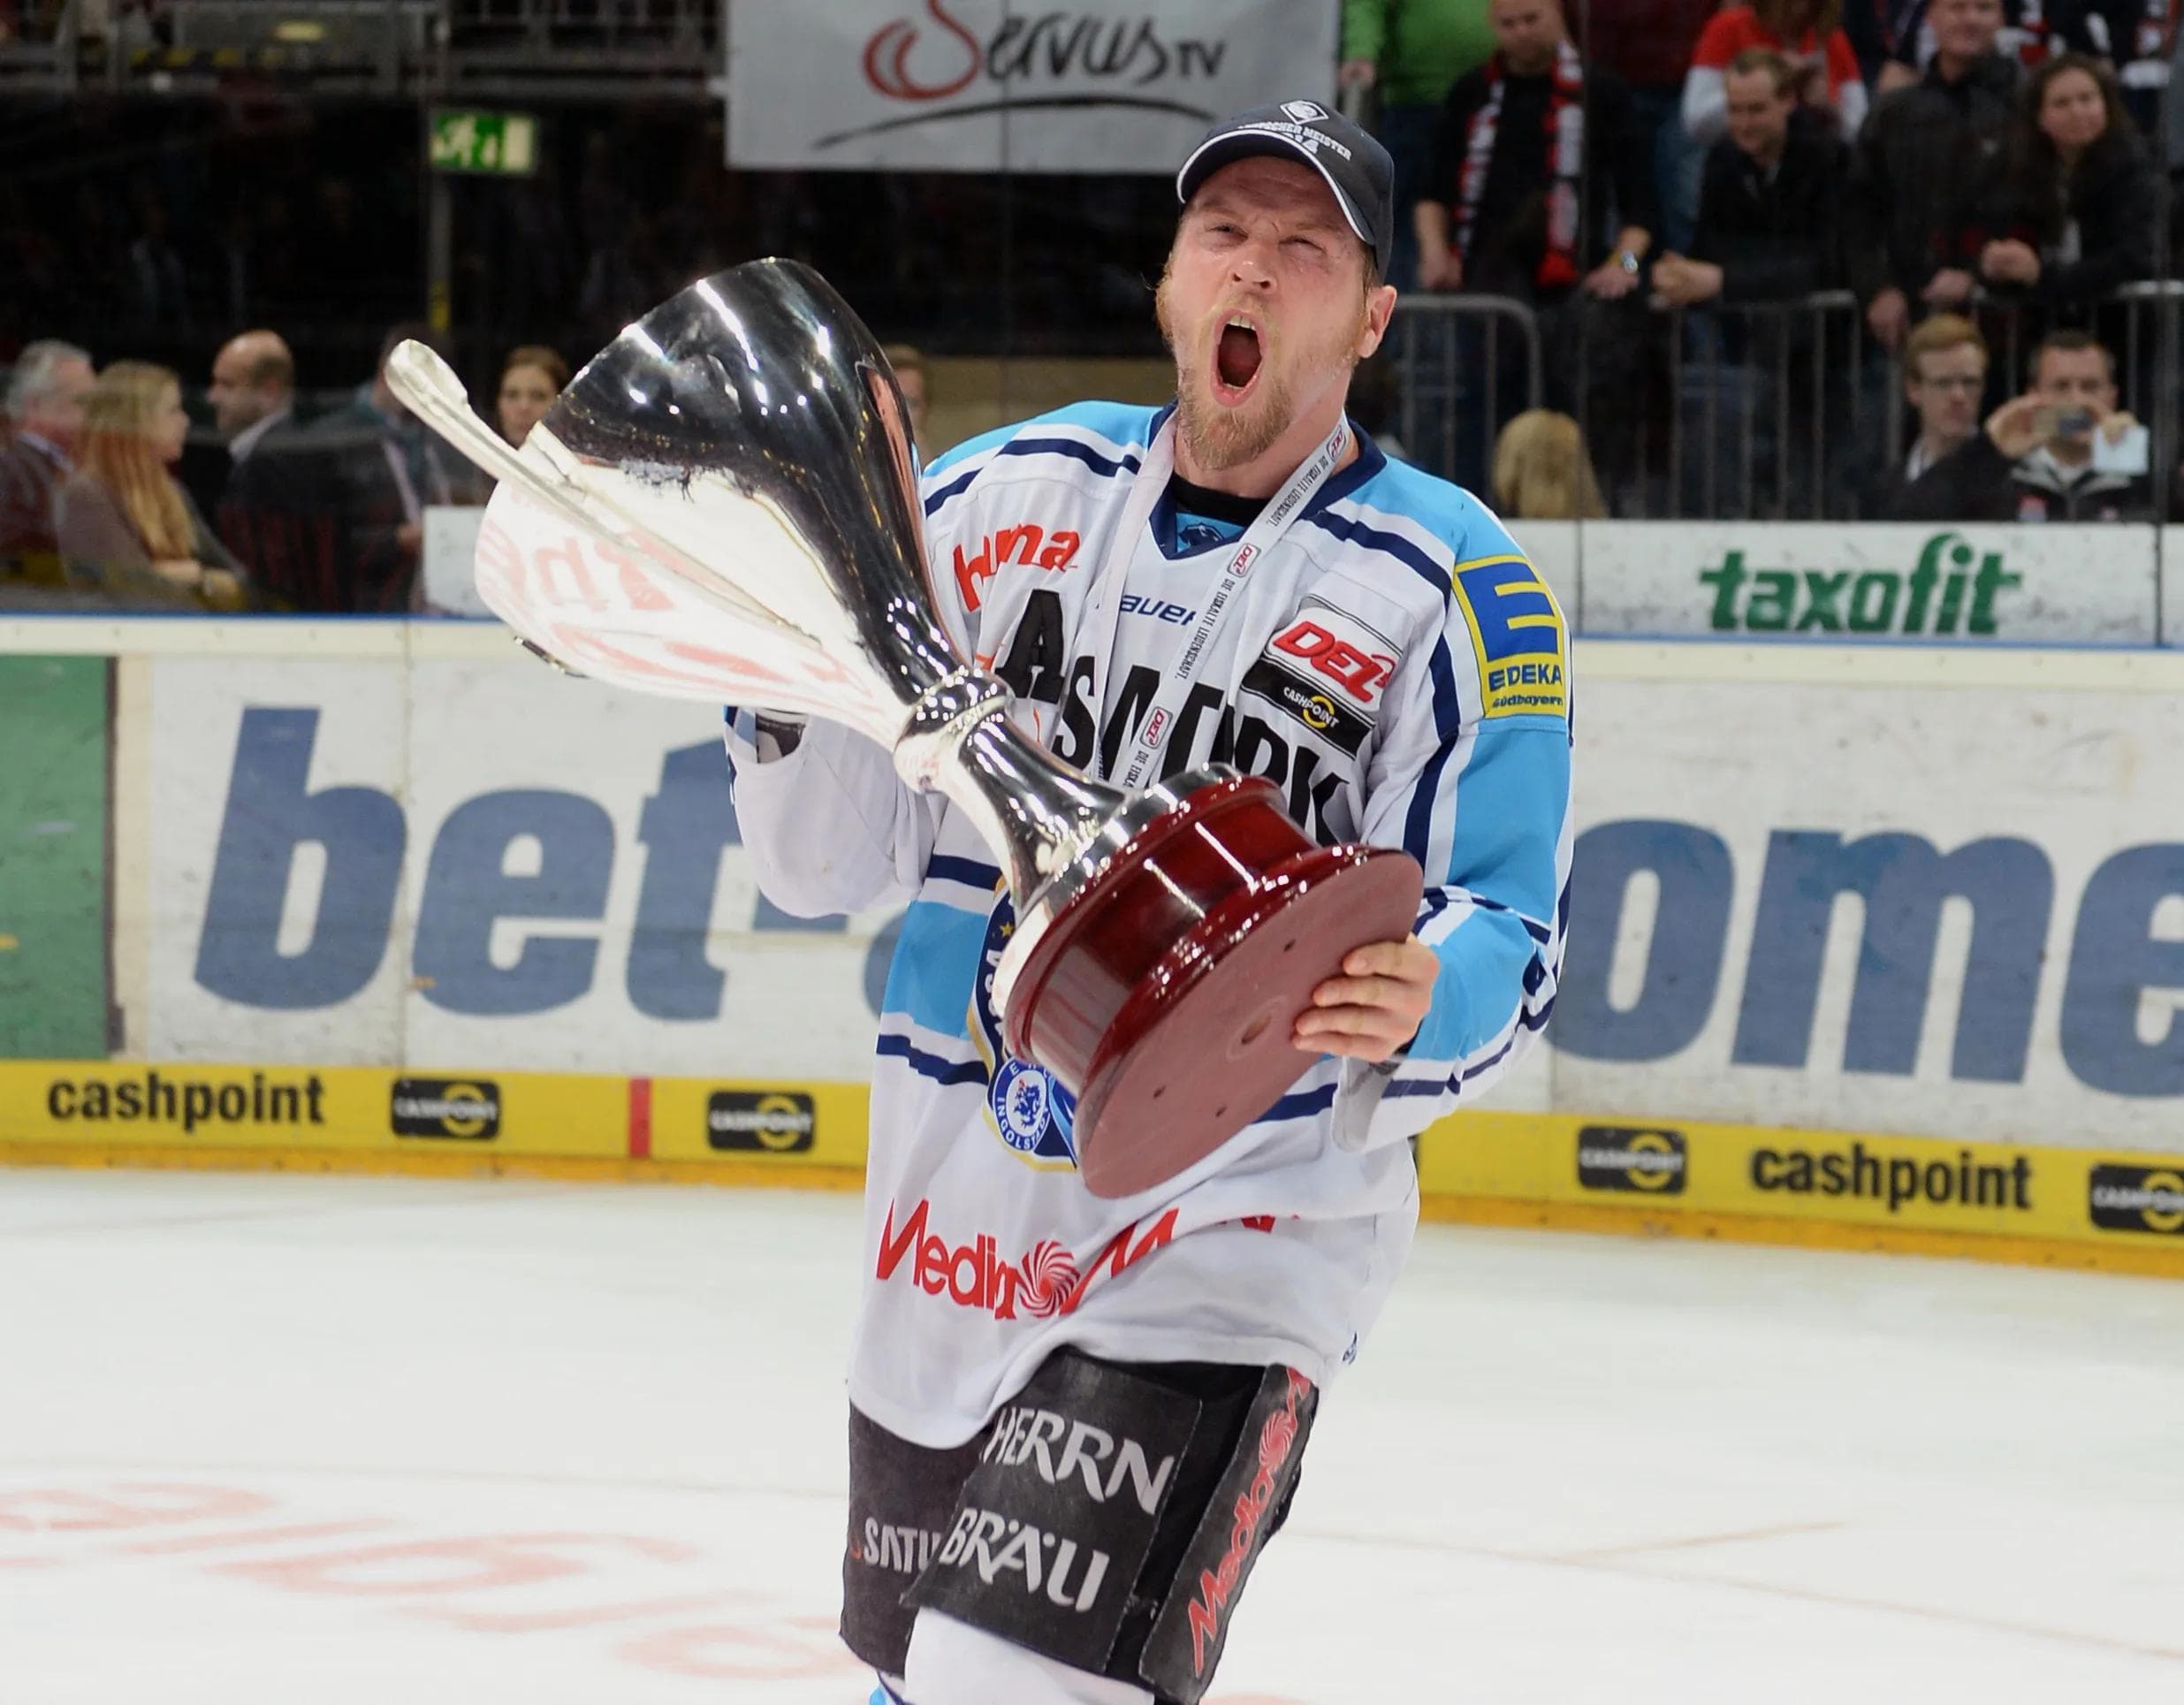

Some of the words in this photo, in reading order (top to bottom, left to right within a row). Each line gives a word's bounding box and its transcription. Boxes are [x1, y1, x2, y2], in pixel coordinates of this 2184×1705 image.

[1303, 126, 1351, 162] MEISTER
[1119, 594, 1197, 626] auer
[1699, 531, 2022, 635] taxofit
[994, 589, 1065, 704] A
[1488, 664, 1564, 692] EDEKA
[1283, 686, 1340, 728] CASHPOINT
[47, 1071, 325, 1133] cashpoint
[1750, 1142, 2032, 1214] cashpoint
[979, 1406, 1175, 1516] HERRN
[864, 1516, 940, 1574] SATU
[938, 1507, 1111, 1613] BRÄU
[1187, 1467, 1275, 1679] Media
